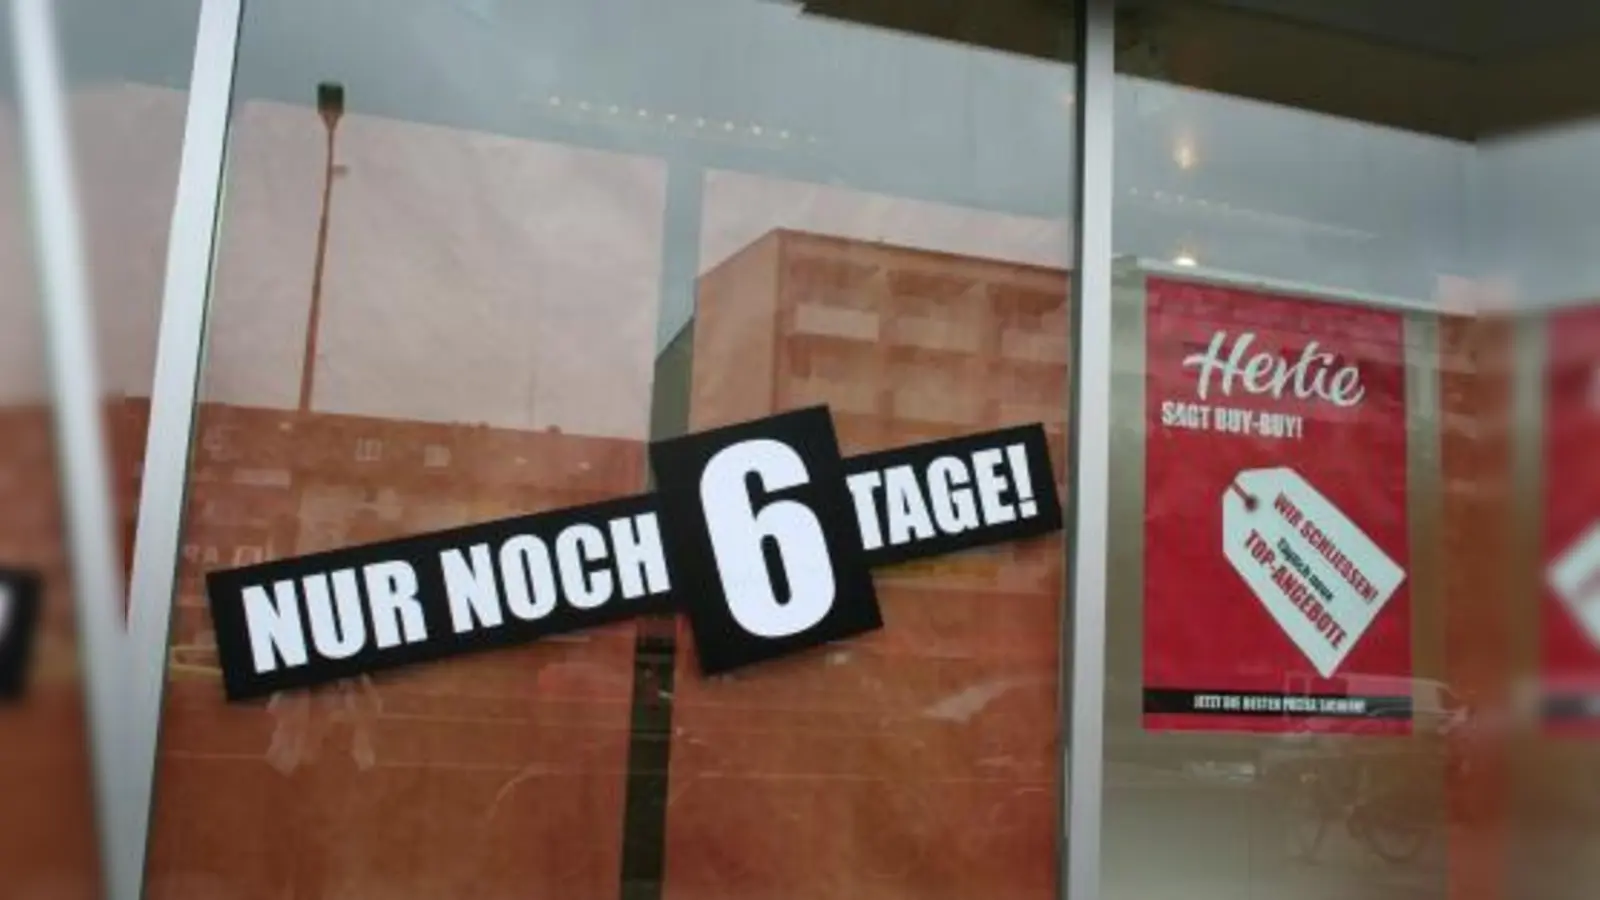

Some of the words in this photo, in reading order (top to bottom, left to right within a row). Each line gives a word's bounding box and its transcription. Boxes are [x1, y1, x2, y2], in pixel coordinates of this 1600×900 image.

[1161, 400, 1212, 429] SAGT
[1214, 407, 1303, 438] BUY-BUY!
[1182, 330, 1365, 407] Hertie
[241, 559, 428, 674] NUR
[439, 511, 671, 634] NOCH
[700, 438, 836, 638] 6
[846, 442, 1039, 551] TAGE!
[1244, 528, 1347, 651] TOP-ANGEBOTE
[1273, 491, 1305, 529] WIR
[1300, 520, 1379, 605] SCHLIESSEN!
